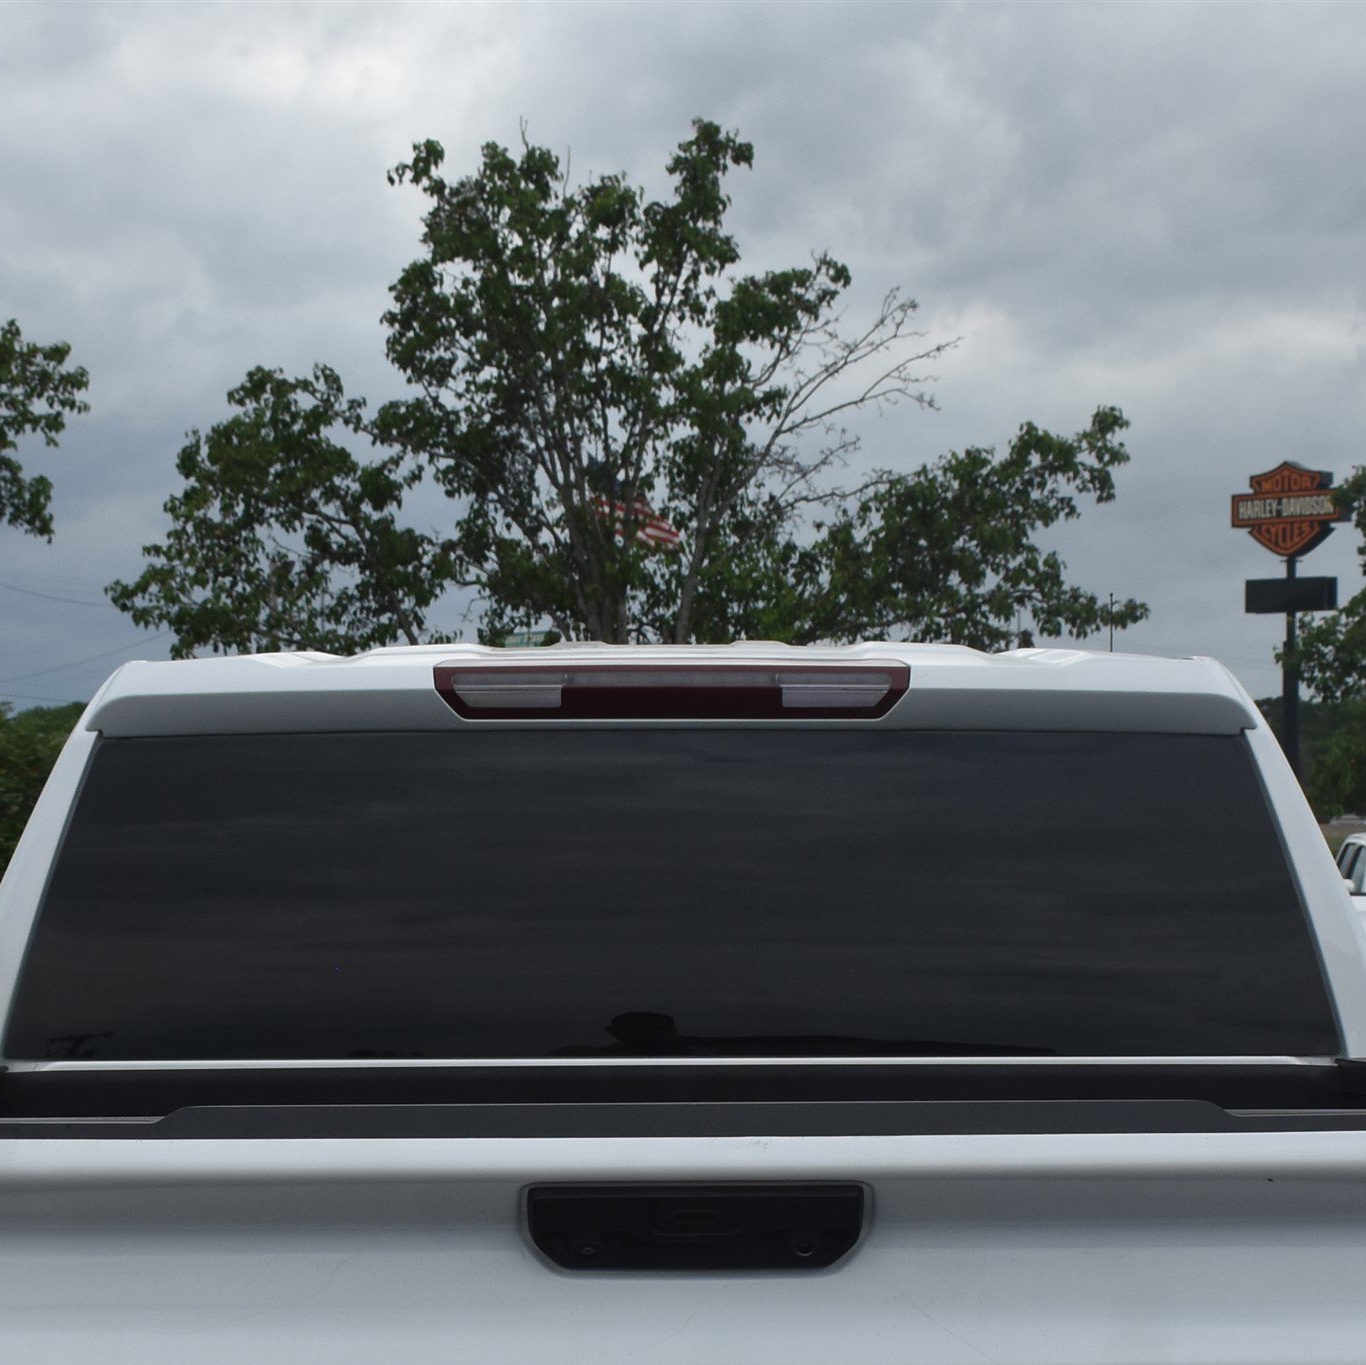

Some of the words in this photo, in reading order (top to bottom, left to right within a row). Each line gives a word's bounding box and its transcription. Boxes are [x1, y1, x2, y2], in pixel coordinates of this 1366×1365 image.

[1261, 473, 1312, 491] MOTOR
[1239, 495, 1334, 518] HARLEY-DAVIDSON
[1261, 523, 1311, 547] CYCLES
